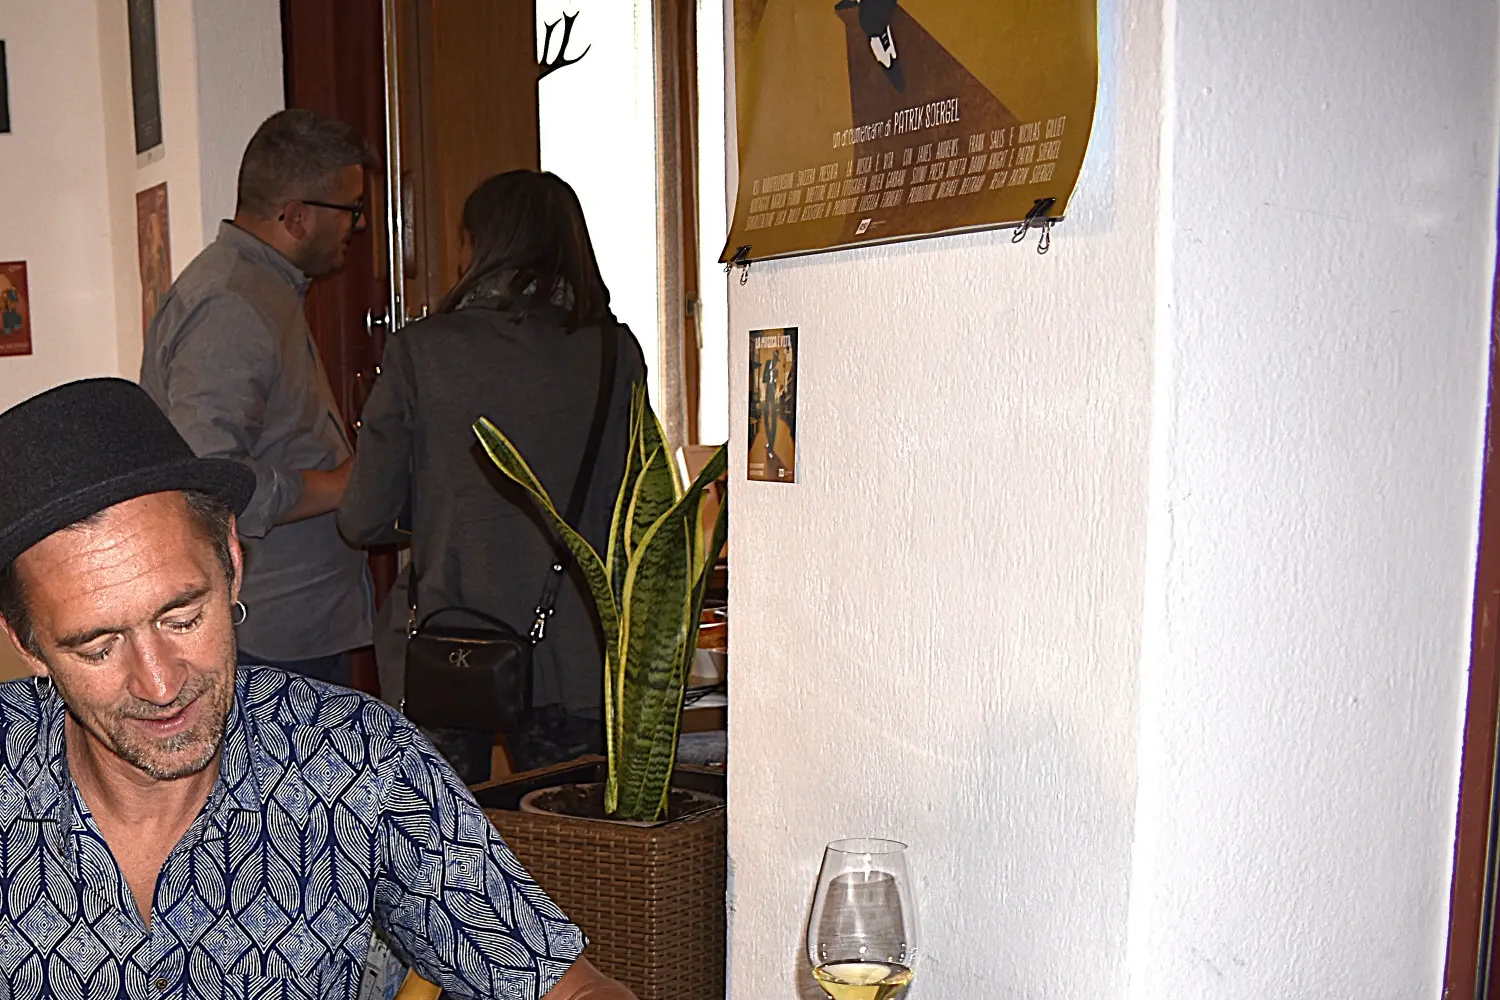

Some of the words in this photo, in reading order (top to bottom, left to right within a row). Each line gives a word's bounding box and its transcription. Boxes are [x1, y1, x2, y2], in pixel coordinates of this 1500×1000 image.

[885, 120, 892, 136] di
[894, 106, 924, 135] PATRIK
[926, 98, 960, 128] SOERGEL
